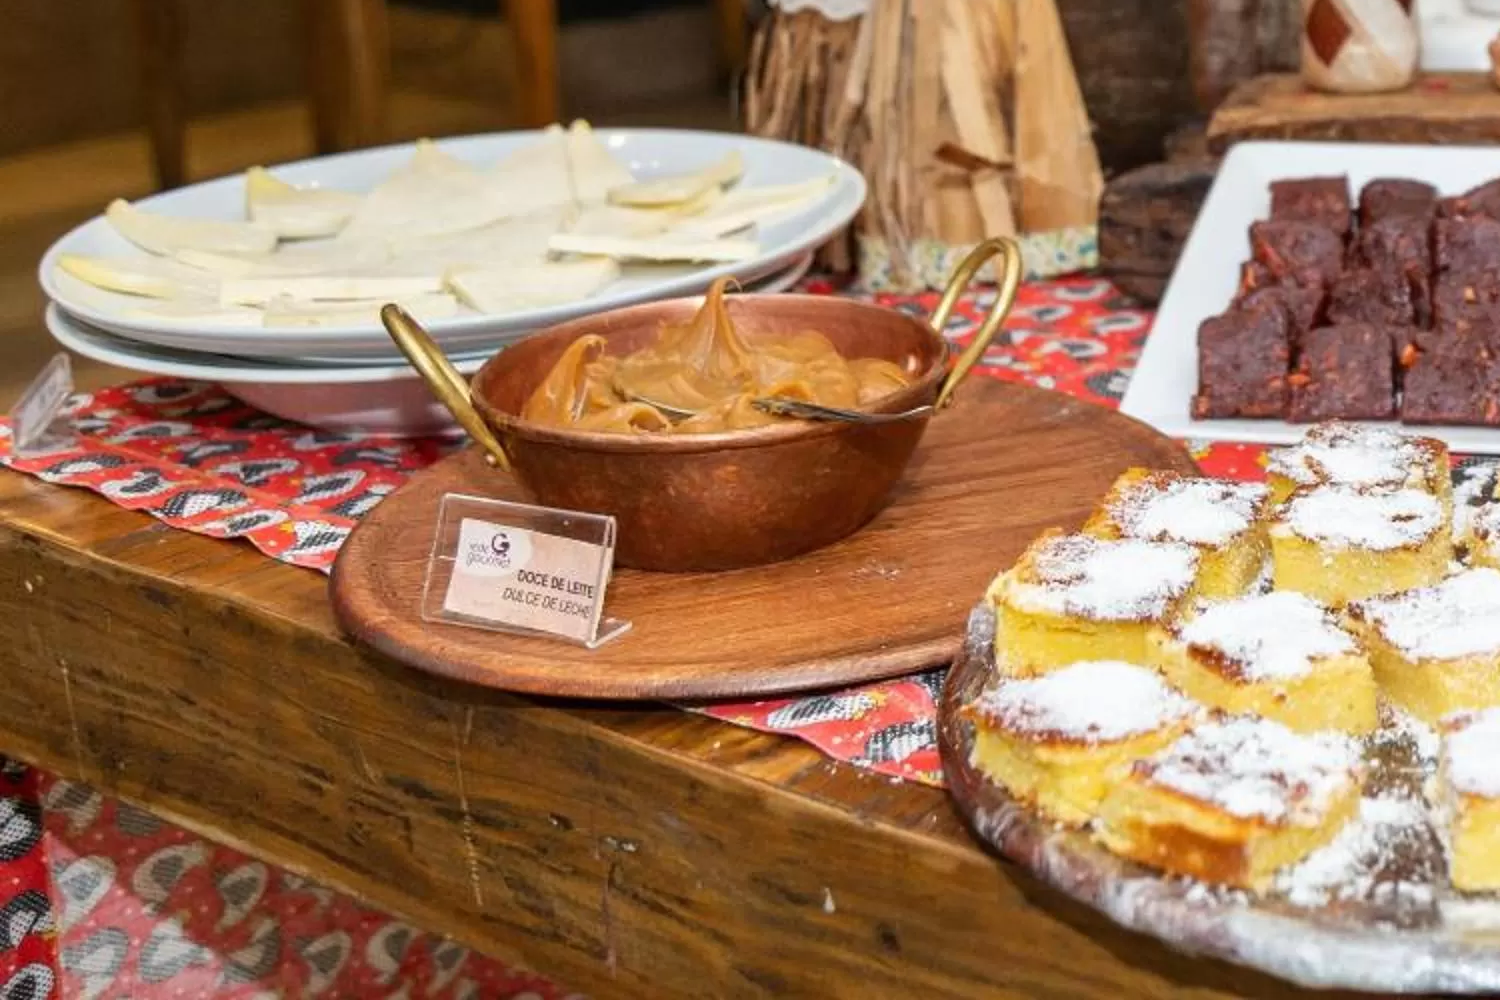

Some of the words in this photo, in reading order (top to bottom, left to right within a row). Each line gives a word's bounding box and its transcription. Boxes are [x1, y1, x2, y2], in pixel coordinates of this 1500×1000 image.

[517, 569, 549, 587] DOCE
[551, 575, 566, 591] DE
[567, 580, 595, 599] LEITE
[502, 587, 541, 606] DULCE
[542, 594, 558, 610] DE
[559, 599, 593, 618] LECHE
